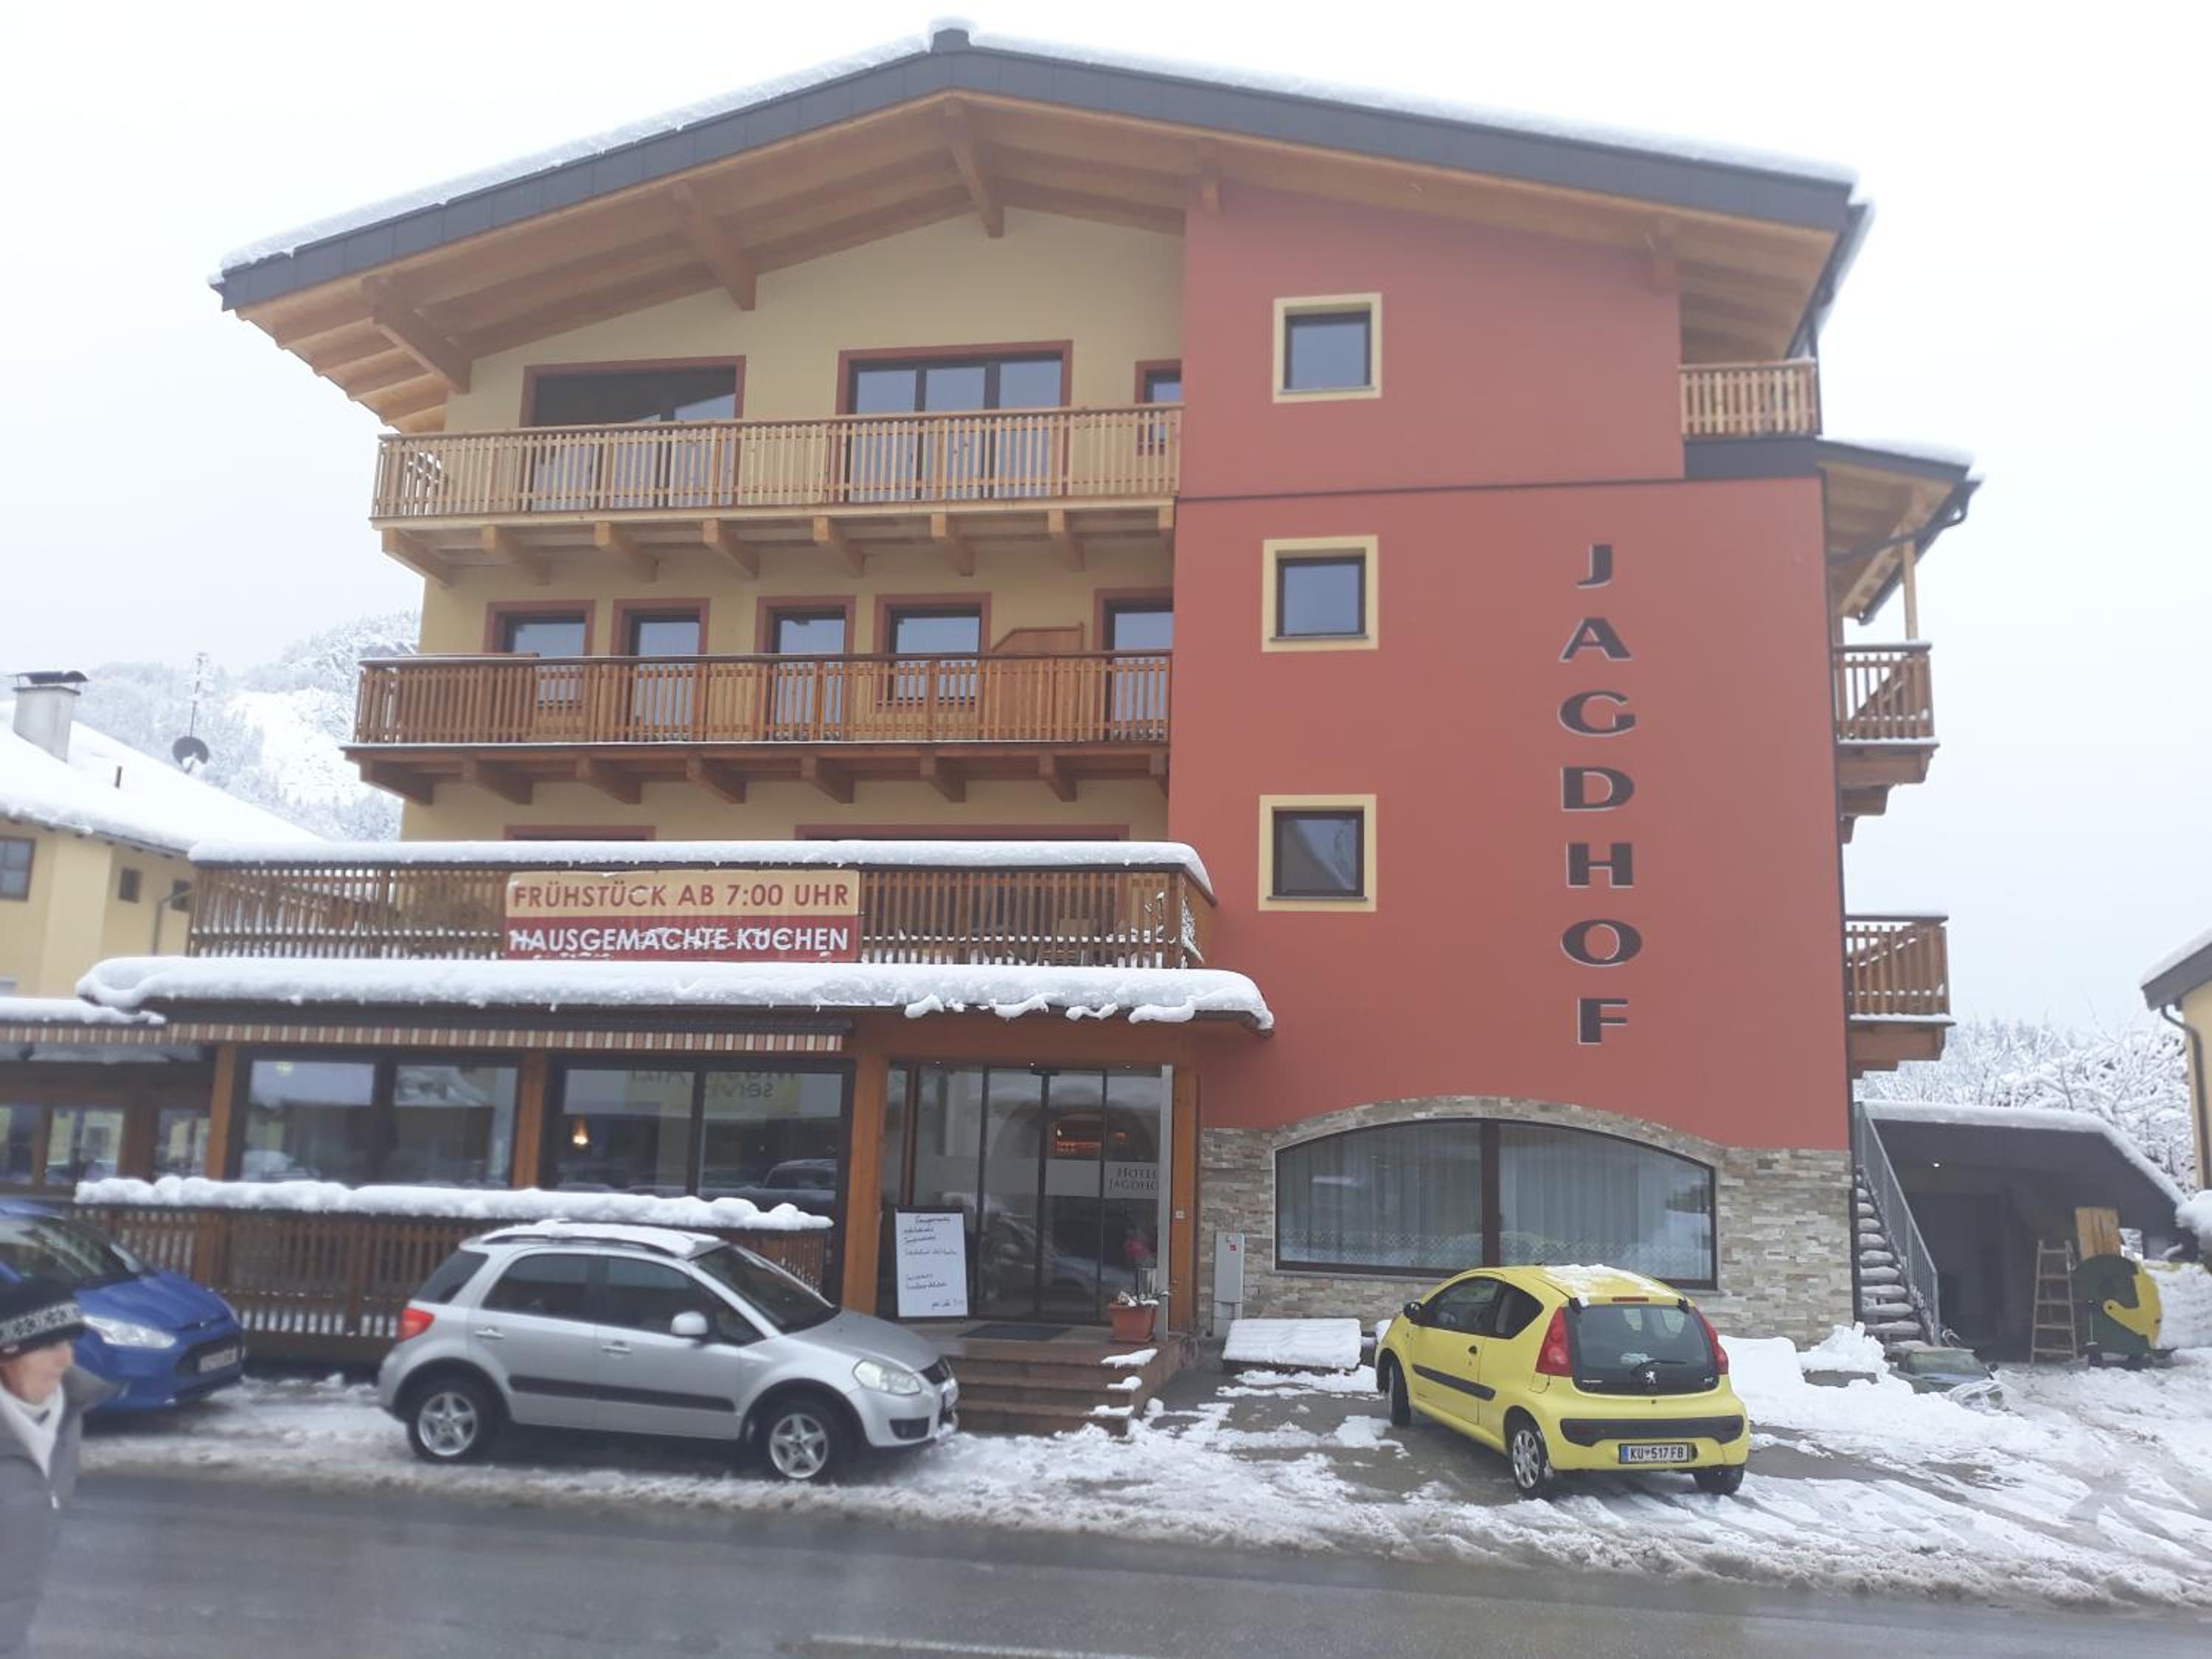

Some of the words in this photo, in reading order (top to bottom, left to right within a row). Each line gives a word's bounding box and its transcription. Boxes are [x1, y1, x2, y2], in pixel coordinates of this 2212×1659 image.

[1557, 543, 1642, 1045] JAGDHOF
[513, 880, 666, 908] FRÜHSTÜCK
[678, 885, 714, 906] AB
[726, 885, 783, 906] 7:00
[794, 885, 848, 906] UHR
[509, 928, 729, 951] HAUSGEMACHTE
[1109, 1179, 1157, 1192] JAGDHO
[1630, 1447, 1644, 1459] KU
